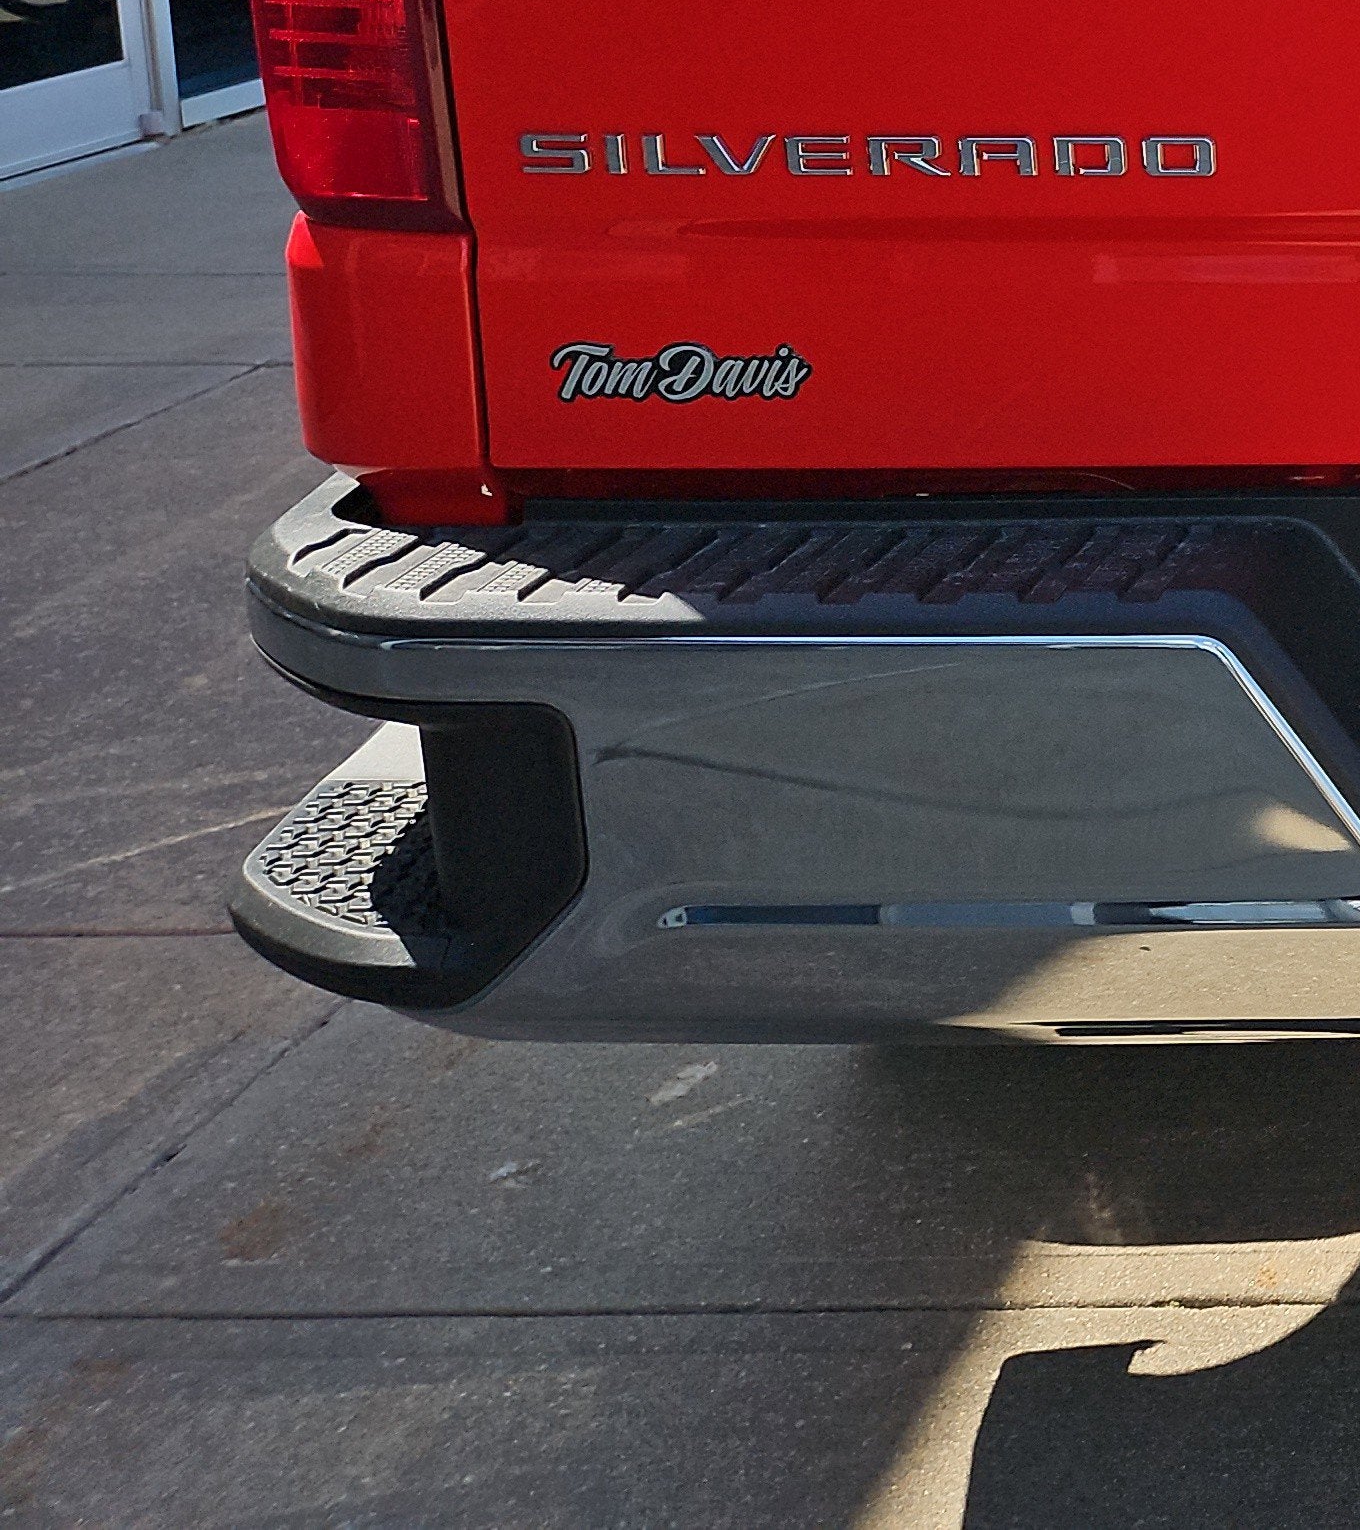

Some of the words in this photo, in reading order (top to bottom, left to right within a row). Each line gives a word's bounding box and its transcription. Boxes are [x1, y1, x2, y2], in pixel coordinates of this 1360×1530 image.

[519, 132, 1218, 177] SILVERADO
[551, 343, 657, 401] Tom
[657, 344, 808, 401] Davis
